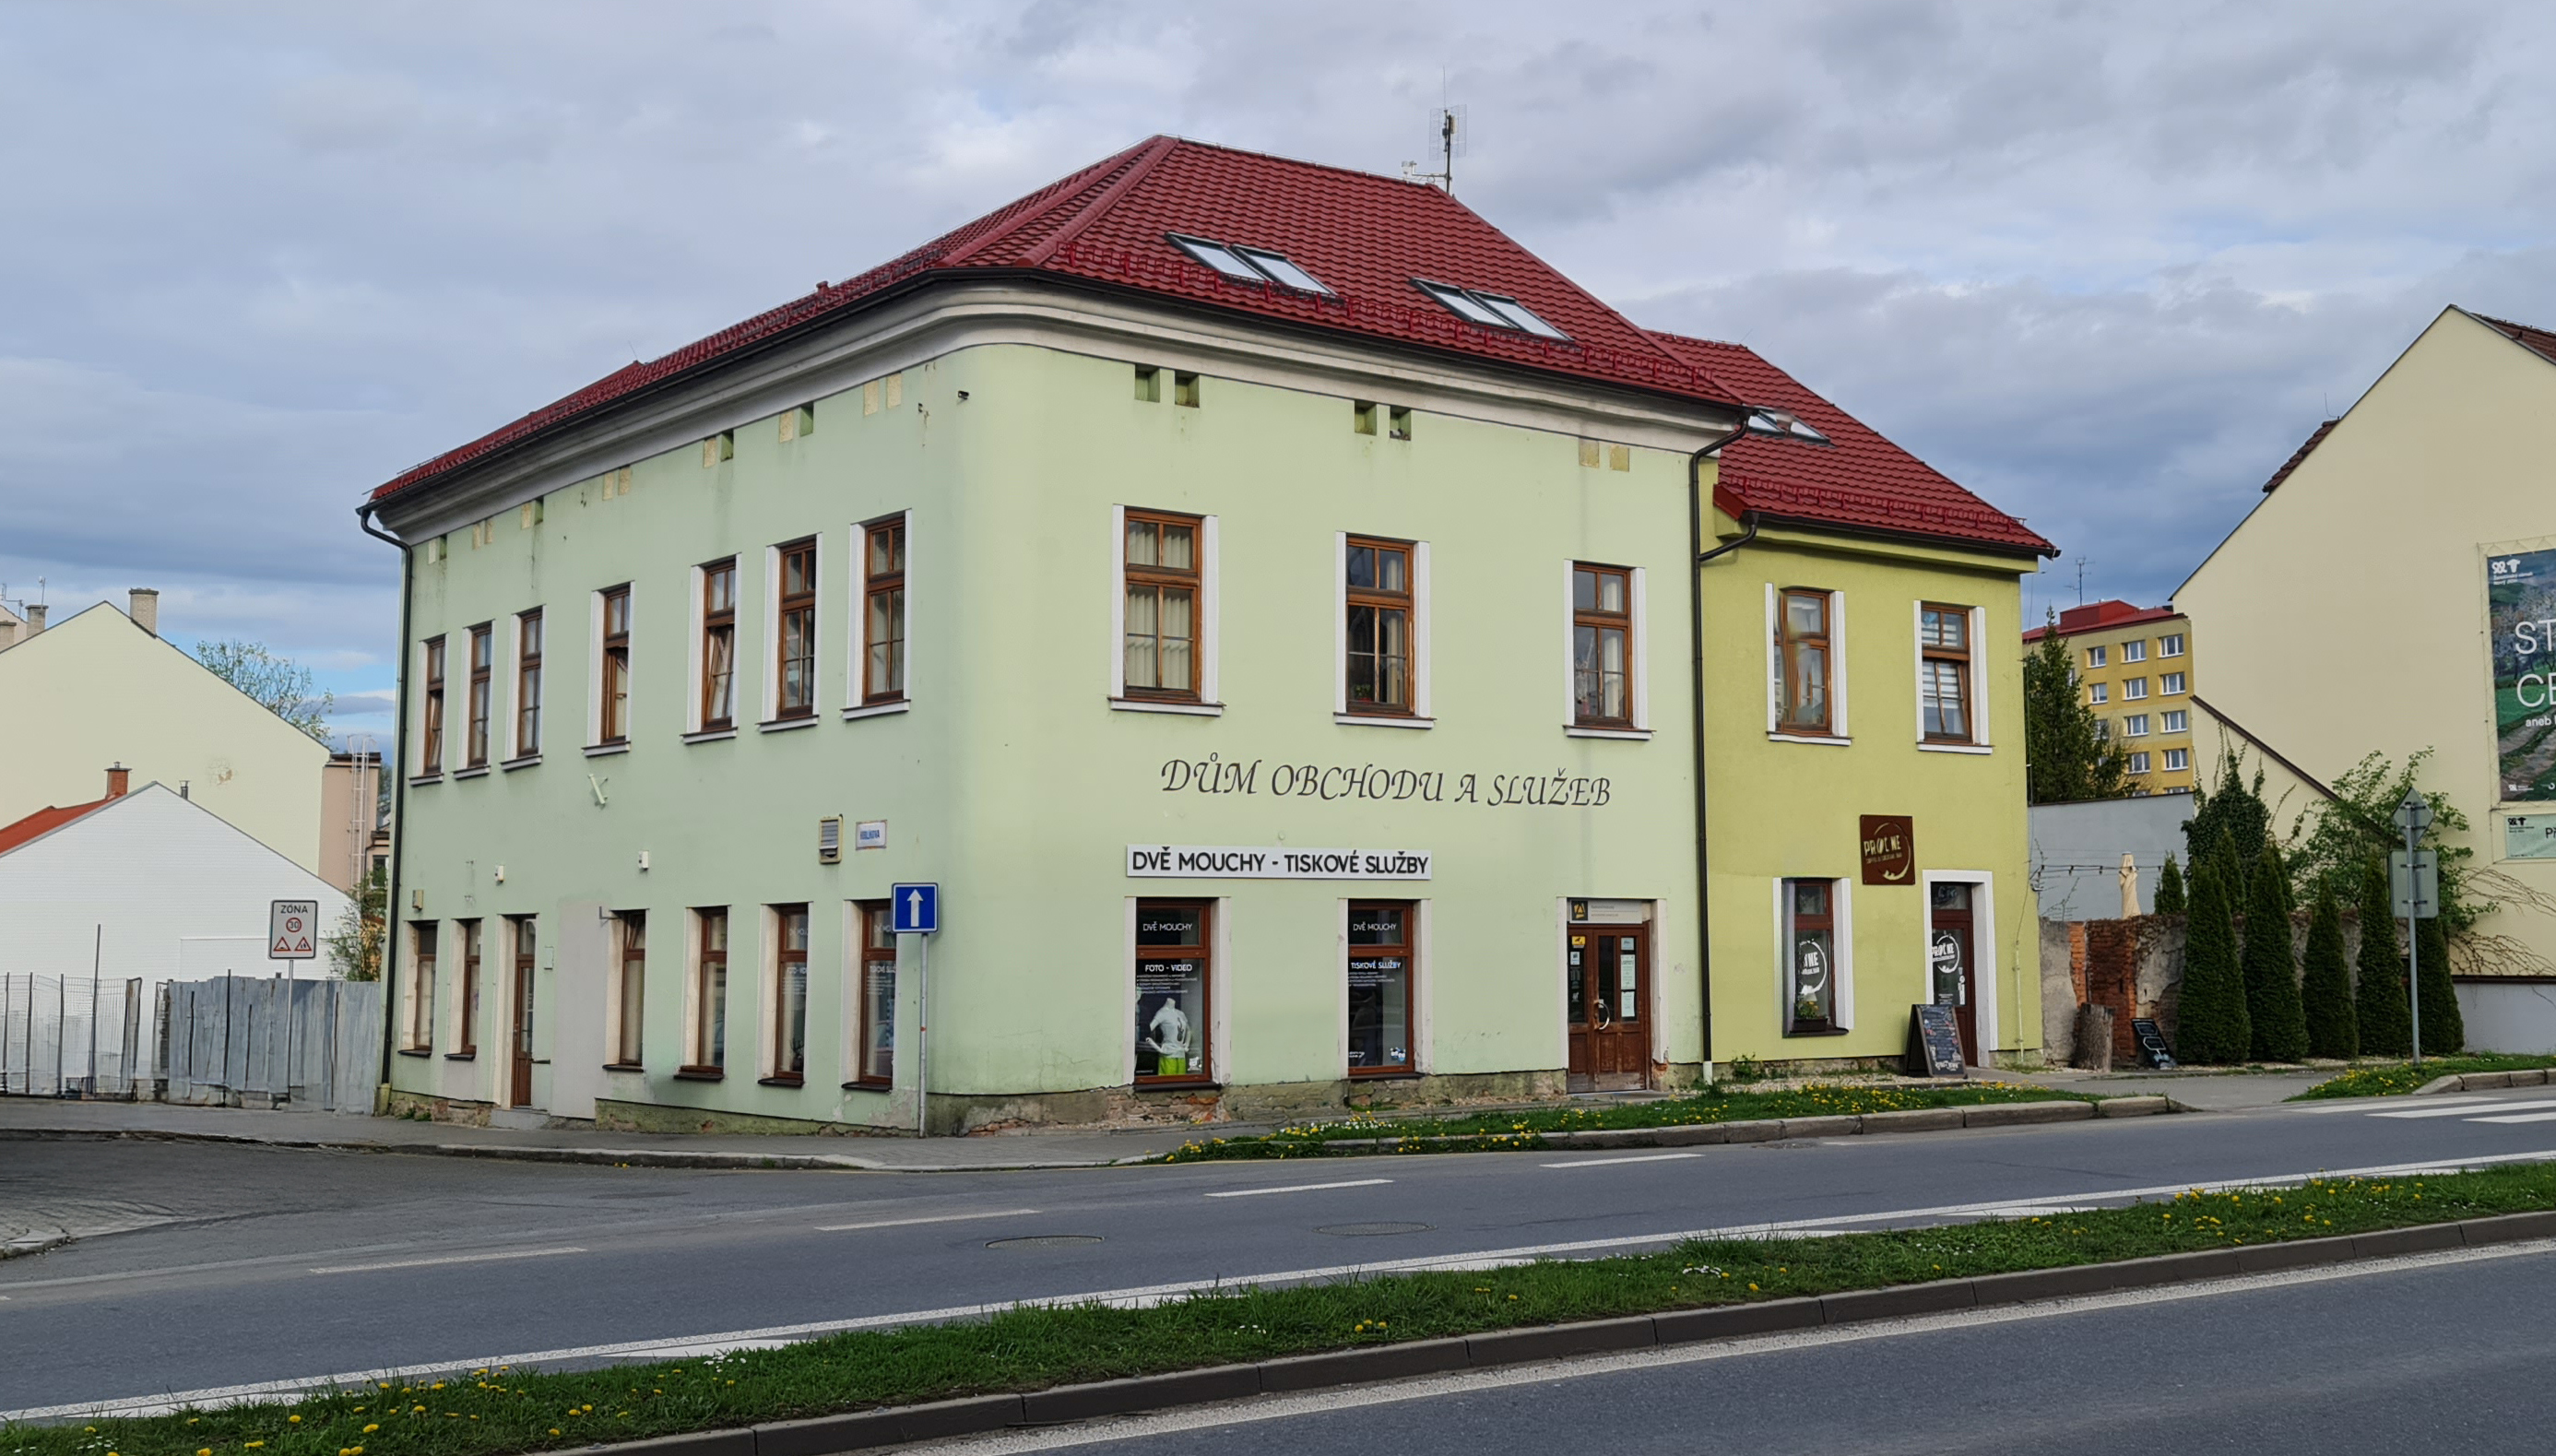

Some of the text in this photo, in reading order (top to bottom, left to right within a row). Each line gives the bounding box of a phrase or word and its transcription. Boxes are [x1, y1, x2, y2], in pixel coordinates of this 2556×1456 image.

[2515, 619, 2556, 655] ST
[2526, 716, 2551, 727] aneb
[1161, 752, 1612, 808] DŮM OBCHODU A SLUŽEB
[1131, 846, 1171, 870] DVĚ
[1178, 852, 1266, 872] MOUCHY
[1284, 850, 1359, 873] TISKOVÉ
[1365, 851, 1429, 874] SLUŽBY
[1159, 923, 1192, 931] MOUCHY
[1367, 923, 1397, 931] MOUCHY
[1171, 964, 1193, 972] VIDEO
